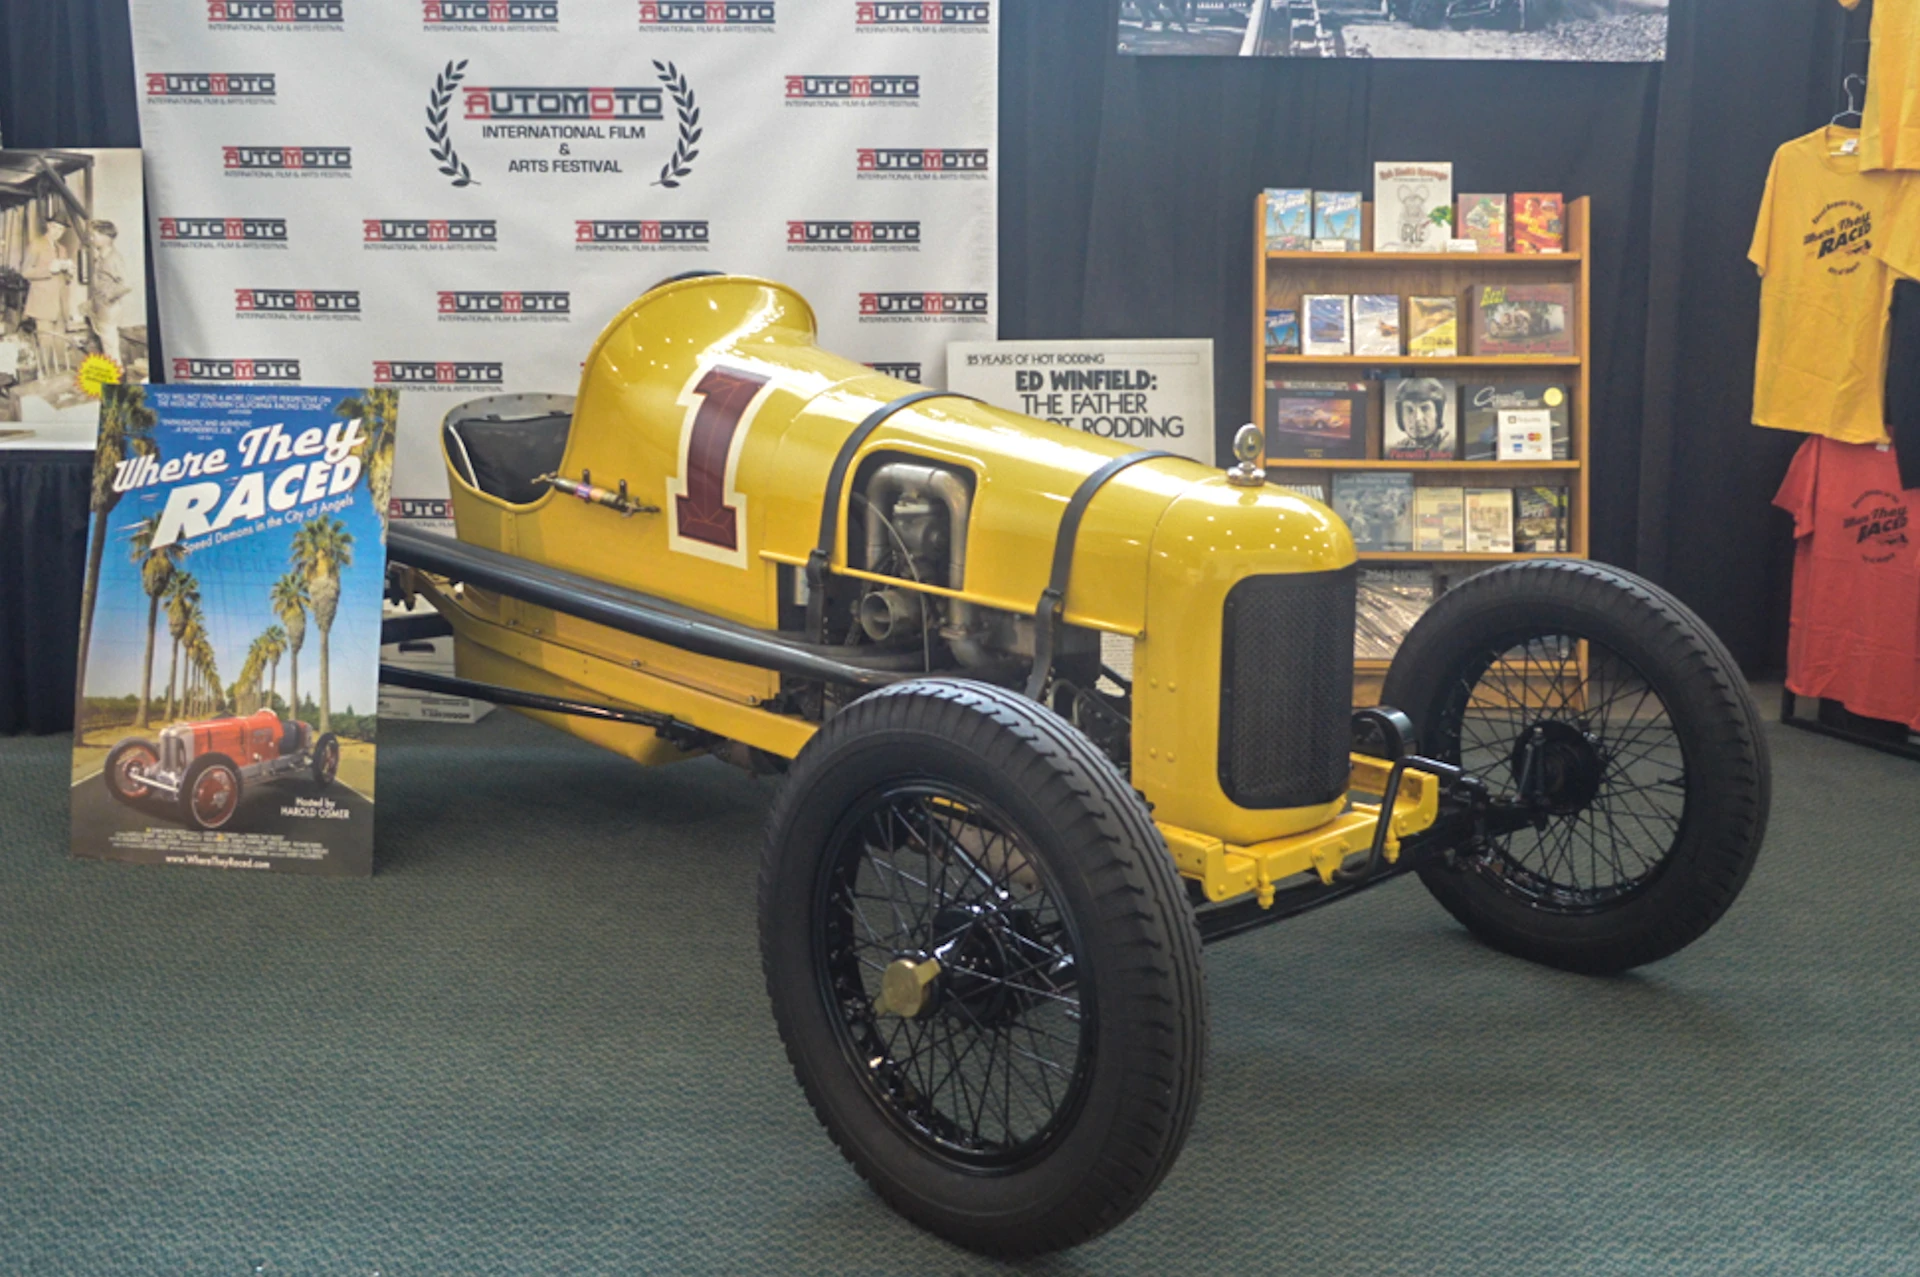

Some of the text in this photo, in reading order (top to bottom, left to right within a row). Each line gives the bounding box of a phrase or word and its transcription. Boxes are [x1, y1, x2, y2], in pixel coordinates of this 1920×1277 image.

[208, 0, 344, 22] AUTOMOTO
[422, 0, 559, 22] AUTOMOTO
[639, 1, 776, 24] AUTOMOTO
[856, 2, 990, 24] AUTOMOTO
[146, 73, 275, 95] AUTOMOTO
[785, 76, 920, 98] AUTOMOTO
[463, 87, 664, 120] AUTOMOTO
[483, 126, 646, 138] INTERNATIONAL FILM
[222, 147, 351, 168] AUTOMOTO
[559, 143, 570, 156] &
[857, 149, 988, 170] AUTOMOTO
[508, 160, 622, 172] ARTS FESTIVAL
[158, 218, 288, 240] AUTOMOTO
[363, 220, 497, 242] AUTOMOTO
[576, 220, 709, 243] AUTOMOTO
[787, 222, 920, 244] AUTOMOTO
[1817, 222, 1872, 260] RACED
[235, 289, 360, 312] AUTOMOTO
[438, 291, 570, 314] AUTOMOTO
[859, 293, 988, 314] AUTOMOTO
[173, 358, 301, 380] AUTOMOTO
[981, 355, 1012, 365] YEARS
[1015, 354, 1030, 364] OF
[1033, 354, 1056, 364] HOT
[1059, 354, 1104, 364] RODDING
[372, 361, 503, 384] AUTOMOTO
[1015, 370, 1158, 392] ED WINFIELD:
[1020, 393, 1148, 414] THE FATHER
[1082, 416, 1184, 438] RODDING
[112, 418, 366, 492] Where They
[669, 361, 773, 563] 1
[150, 454, 362, 550] RACED
[389, 498, 455, 519] AUTO
[215, 525, 254, 544] Demons
[256, 521, 266, 532] in
[266, 516, 282, 528] the
[285, 511, 304, 524] City
[306, 504, 318, 517] of
[320, 494, 354, 514] Angels
